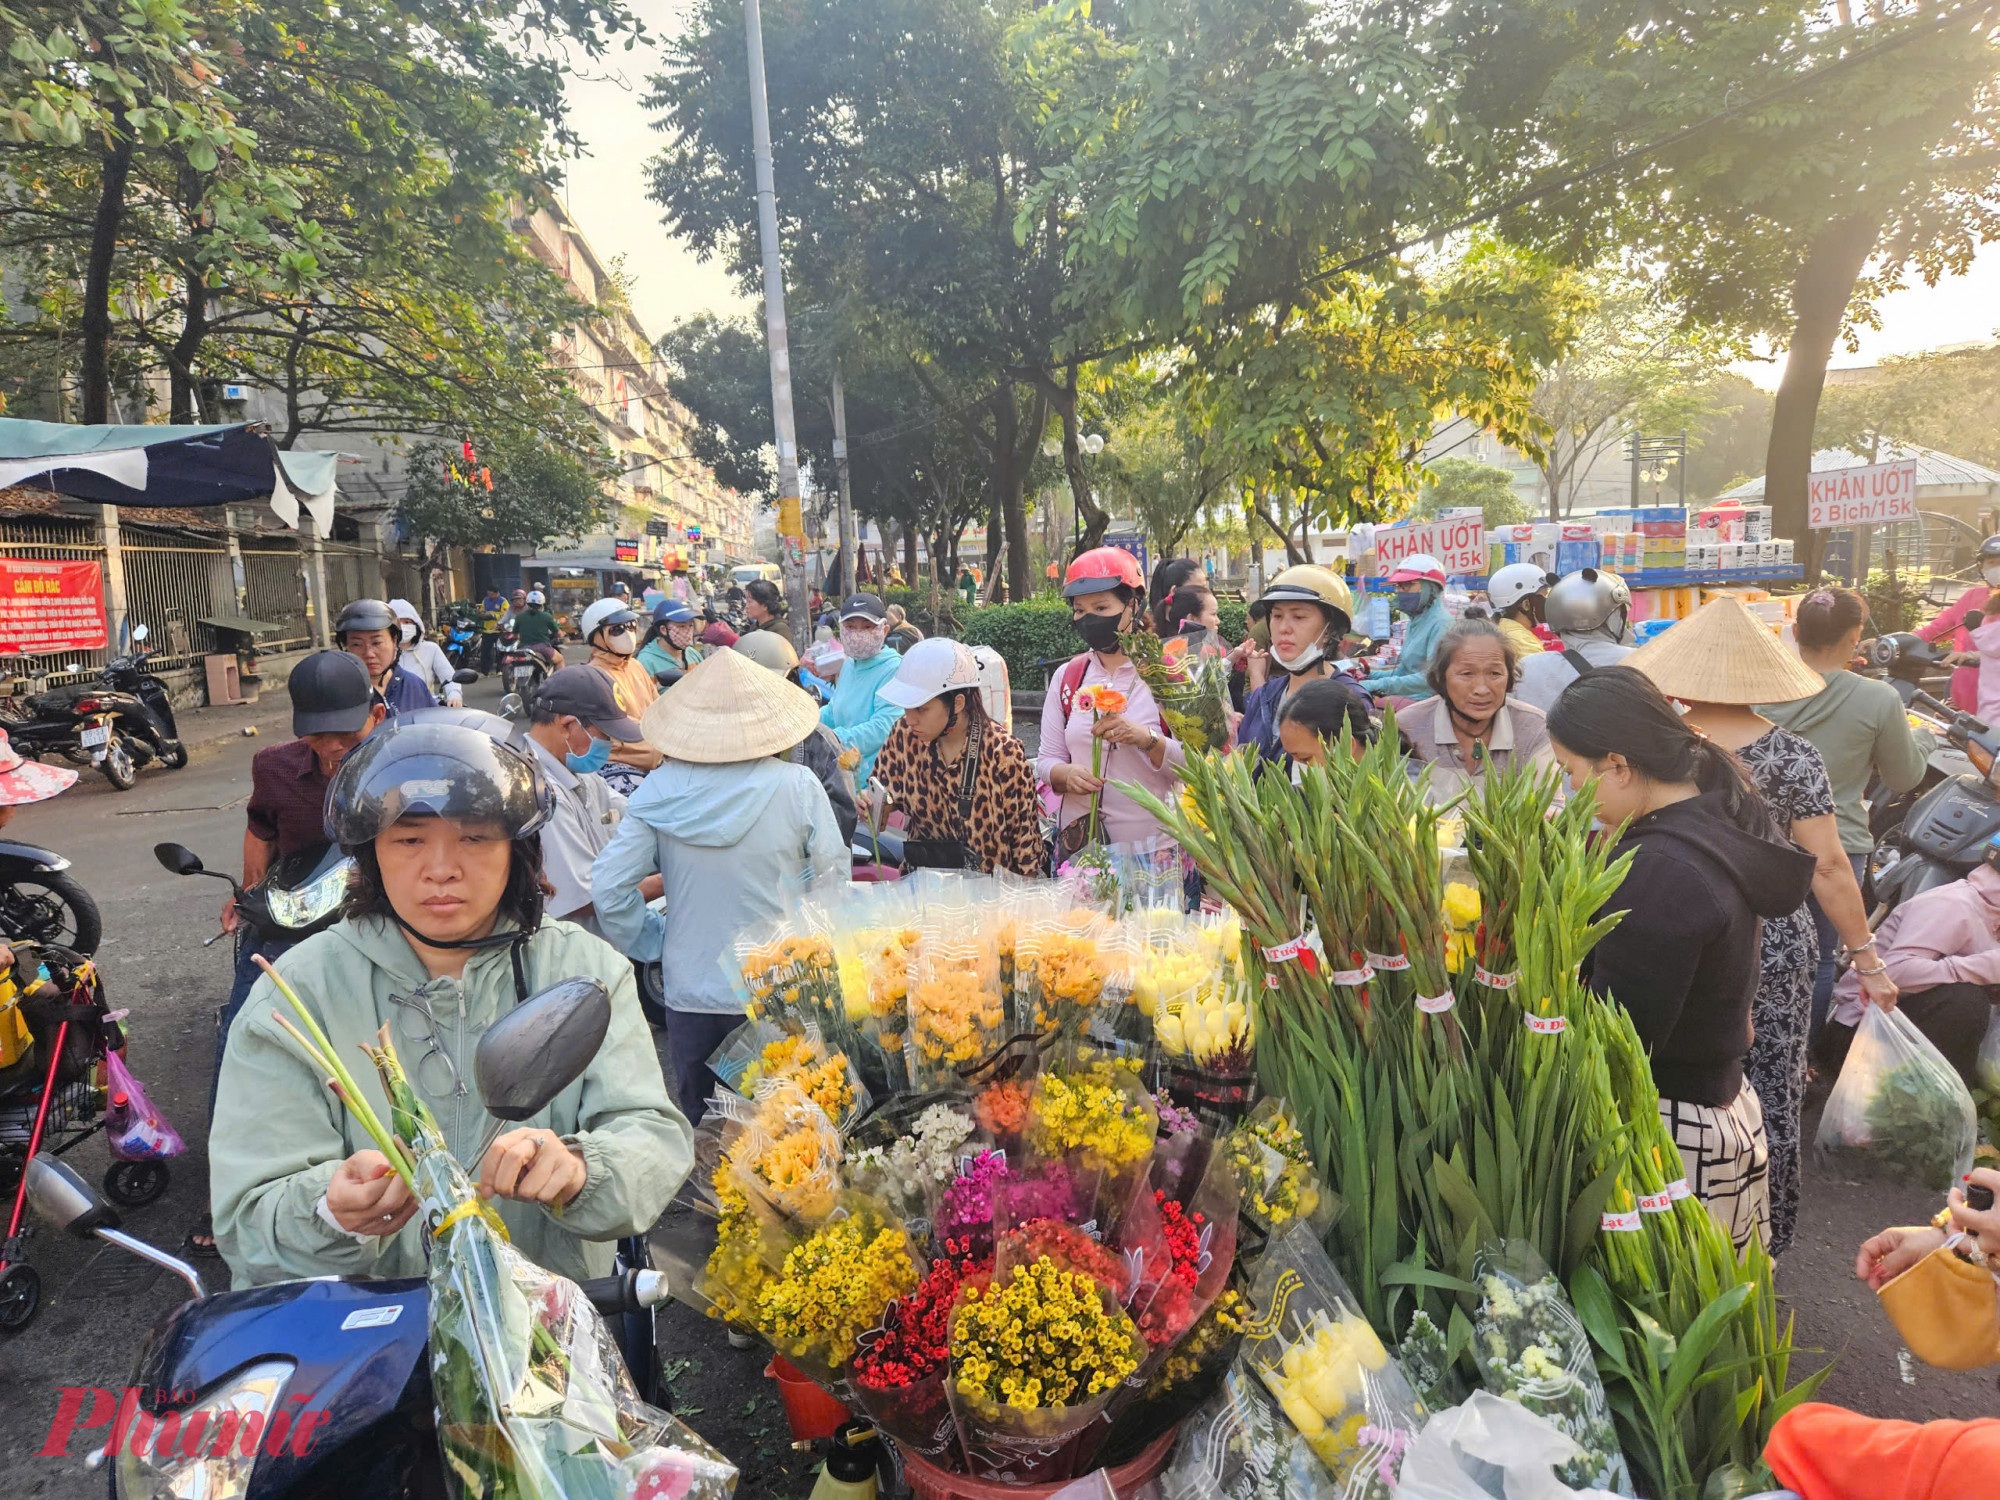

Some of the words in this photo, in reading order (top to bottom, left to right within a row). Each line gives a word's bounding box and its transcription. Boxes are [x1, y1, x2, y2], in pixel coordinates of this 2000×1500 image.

[1811, 471, 1865, 503] KHĂN
[1872, 464, 1913, 497] ƯỚT
[1812, 507, 1821, 523] 2
[1829, 498, 1912, 524] Bịch/15k
[1378, 528, 1433, 561] KHĂN
[1441, 519, 1482, 551] ƯỚT
[1443, 550, 1482, 569] /15k
[344, 1306, 400, 1328] Fi
